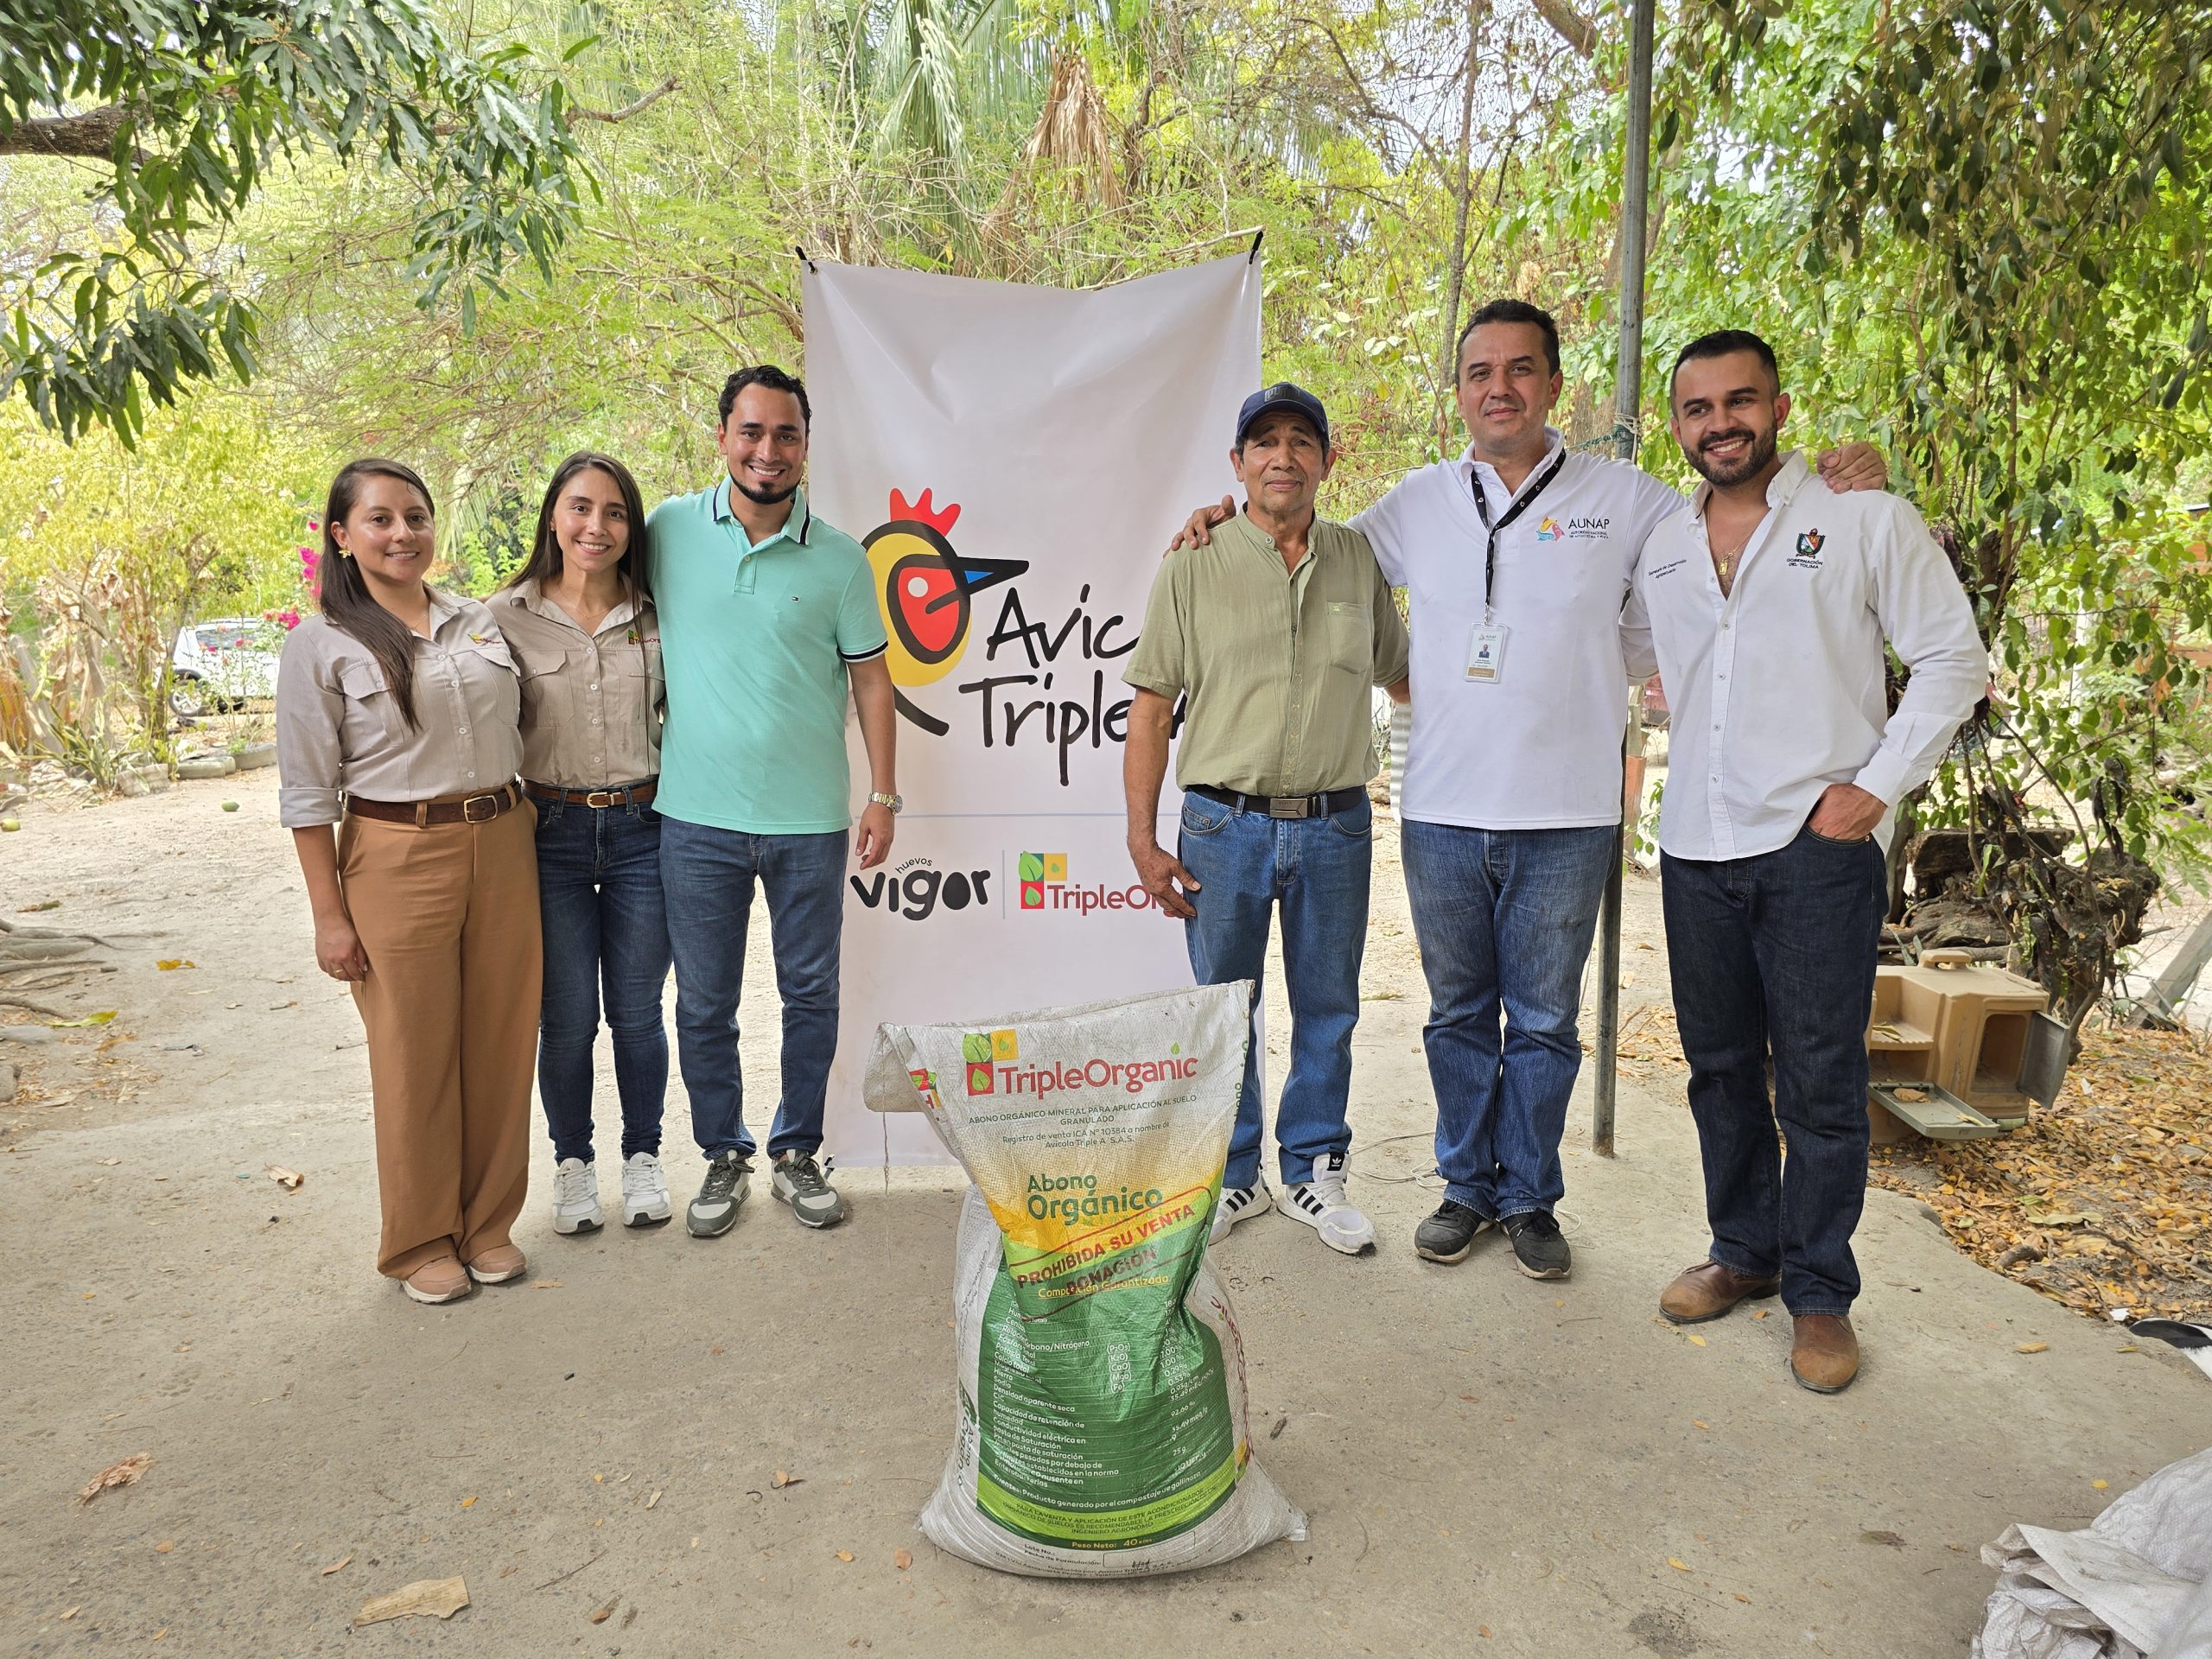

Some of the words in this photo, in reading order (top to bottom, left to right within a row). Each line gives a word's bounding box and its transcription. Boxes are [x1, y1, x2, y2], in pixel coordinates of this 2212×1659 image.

[1568, 518, 1610, 529] AUNAP
[895, 857, 933, 874] huevos
[849, 869, 991, 921] vigor
[998, 1056, 1199, 1100] TripleOrganic
[969, 1114, 999, 1124] ABONO
[1048, 1107, 1087, 1117] MINERAL
[1088, 1105, 1111, 1114] PARA
[1112, 1100, 1162, 1112] APLICACIÓN
[1173, 1095, 1197, 1105] SUELO
[1060, 1115, 1115, 1126] GRANULADO
[1002, 1134, 1034, 1145] Registro
[1036, 1132, 1046, 1141] de
[1047, 1131, 1071, 1140] venta
[1073, 1129, 1088, 1138] ICA
[1102, 1127, 1127, 1135] 10384
[1135, 1122, 1161, 1133] nombre
[1076, 1137, 1098, 1147] Triple
[1099, 1136, 1106, 1145] A
[1109, 1135, 1135, 1144] S.A.S.
[1027, 1173, 1097, 1192] Abono
[1027, 1186, 1163, 1226] Orgánico
[1017, 1243, 1106, 1288] PROHIBIDA
[1109, 1230, 1134, 1251] SU
[1136, 1205, 1195, 1238] VENTA
[1101, 1274, 1170, 1289] Garantizada
[994, 1351, 1013, 1366] Calcio
[994, 1367, 1014, 1381] Hierro
[1110, 1382, 1125, 1394] (Fe)
[994, 1376, 1012, 1389] Sodio
[994, 1383, 1023, 1402] Densidad
[1023, 1396, 1057, 1409] aparente
[994, 1392, 1005, 1402] CIC
[994, 1401, 1028, 1419] Capacidad
[1028, 1414, 1038, 1422] de
[1038, 1416, 1075, 1428] retención
[1075, 1421, 1085, 1429] de
[994, 1417, 1042, 1440] Conductividad
[1042, 1432, 1076, 1444] eléctrica
[1020, 1435, 1062, 1450] Saturación
[1020, 1452, 1050, 1465] pesados
[1050, 1458, 1065, 1467] por
[1065, 1461, 1093, 1470] debajo
[1041, 1447, 1084, 1460] saturación
[1022, 1489, 1056, 1504] Producto
[1057, 1499, 1095, 1509] generado
[1116, 1490, 1161, 1506] compostaje
[1171, 1471, 1201, 1491] gallinaza
